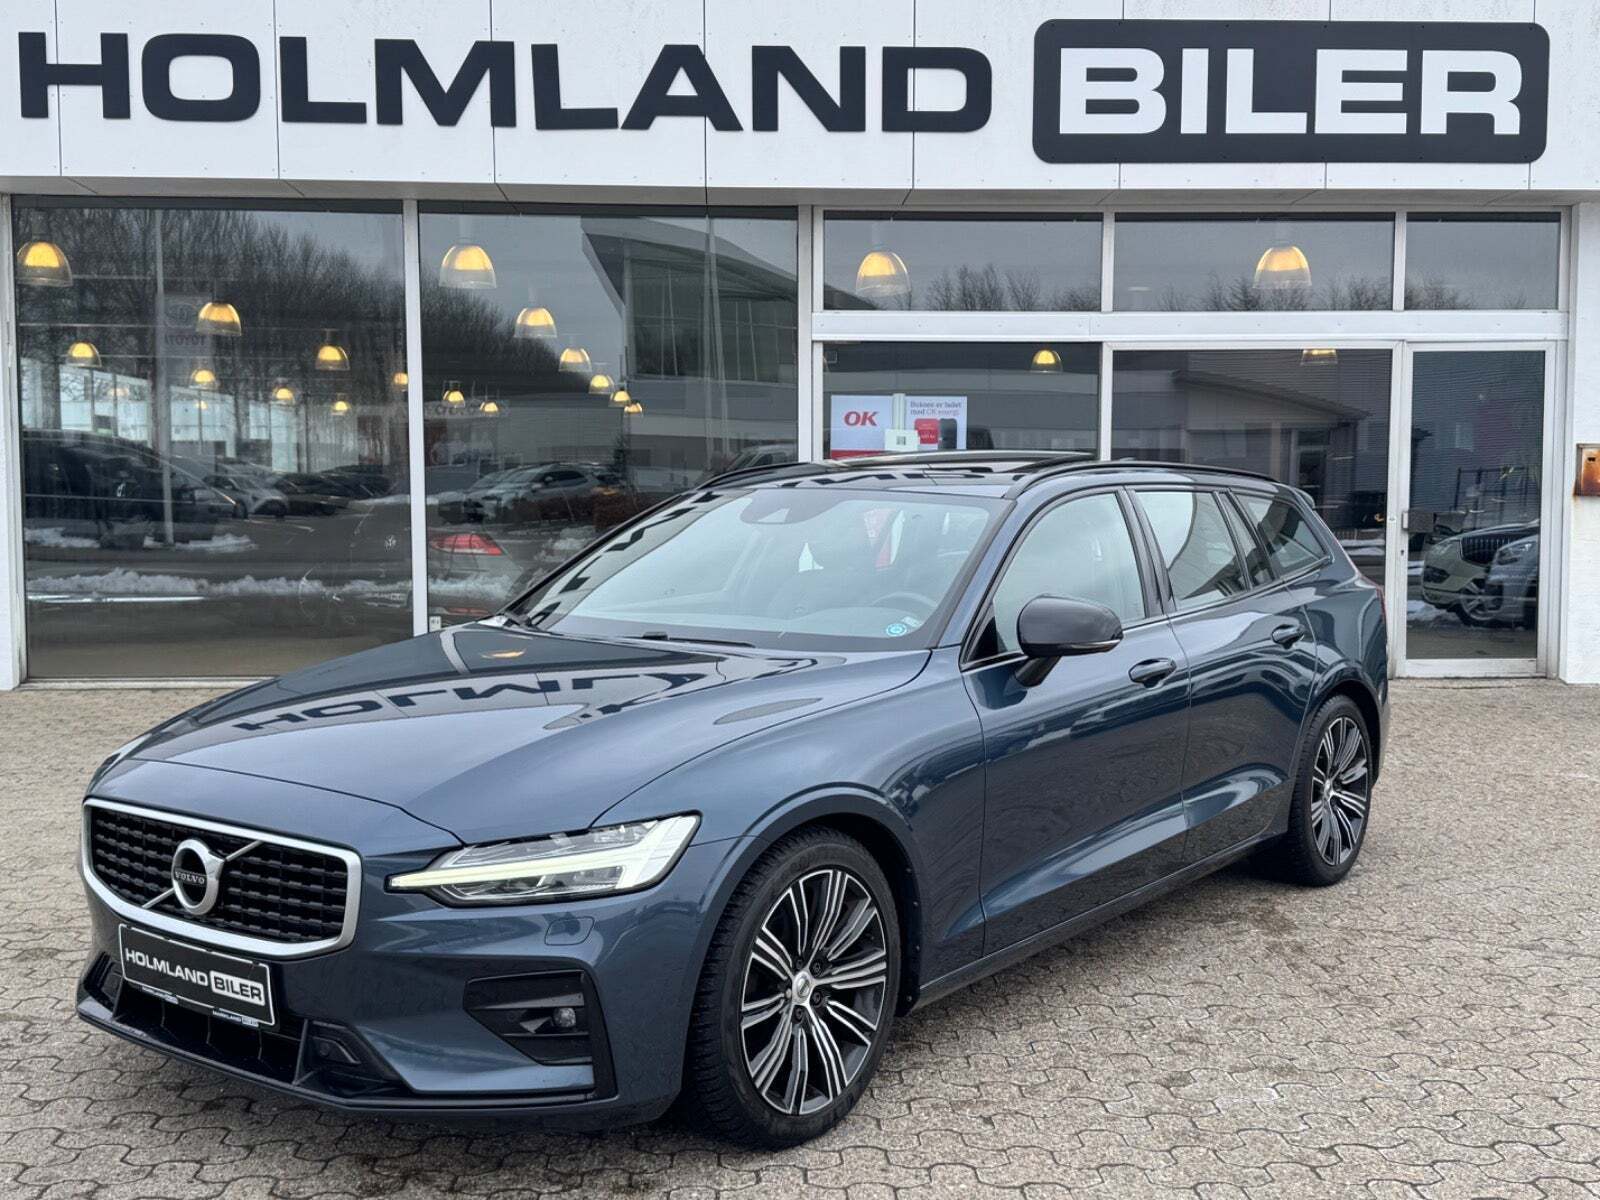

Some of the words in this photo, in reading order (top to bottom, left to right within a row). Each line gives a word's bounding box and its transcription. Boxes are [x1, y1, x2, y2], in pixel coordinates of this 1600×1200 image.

[18, 31, 993, 132] HOLMLAND
[1059, 47, 1523, 136] BILER
[843, 411, 878, 426] OK
[175, 871, 205, 885] VOLVO
[125, 948, 208, 986] HOLMLAND
[214, 976, 262, 1001] BILER
